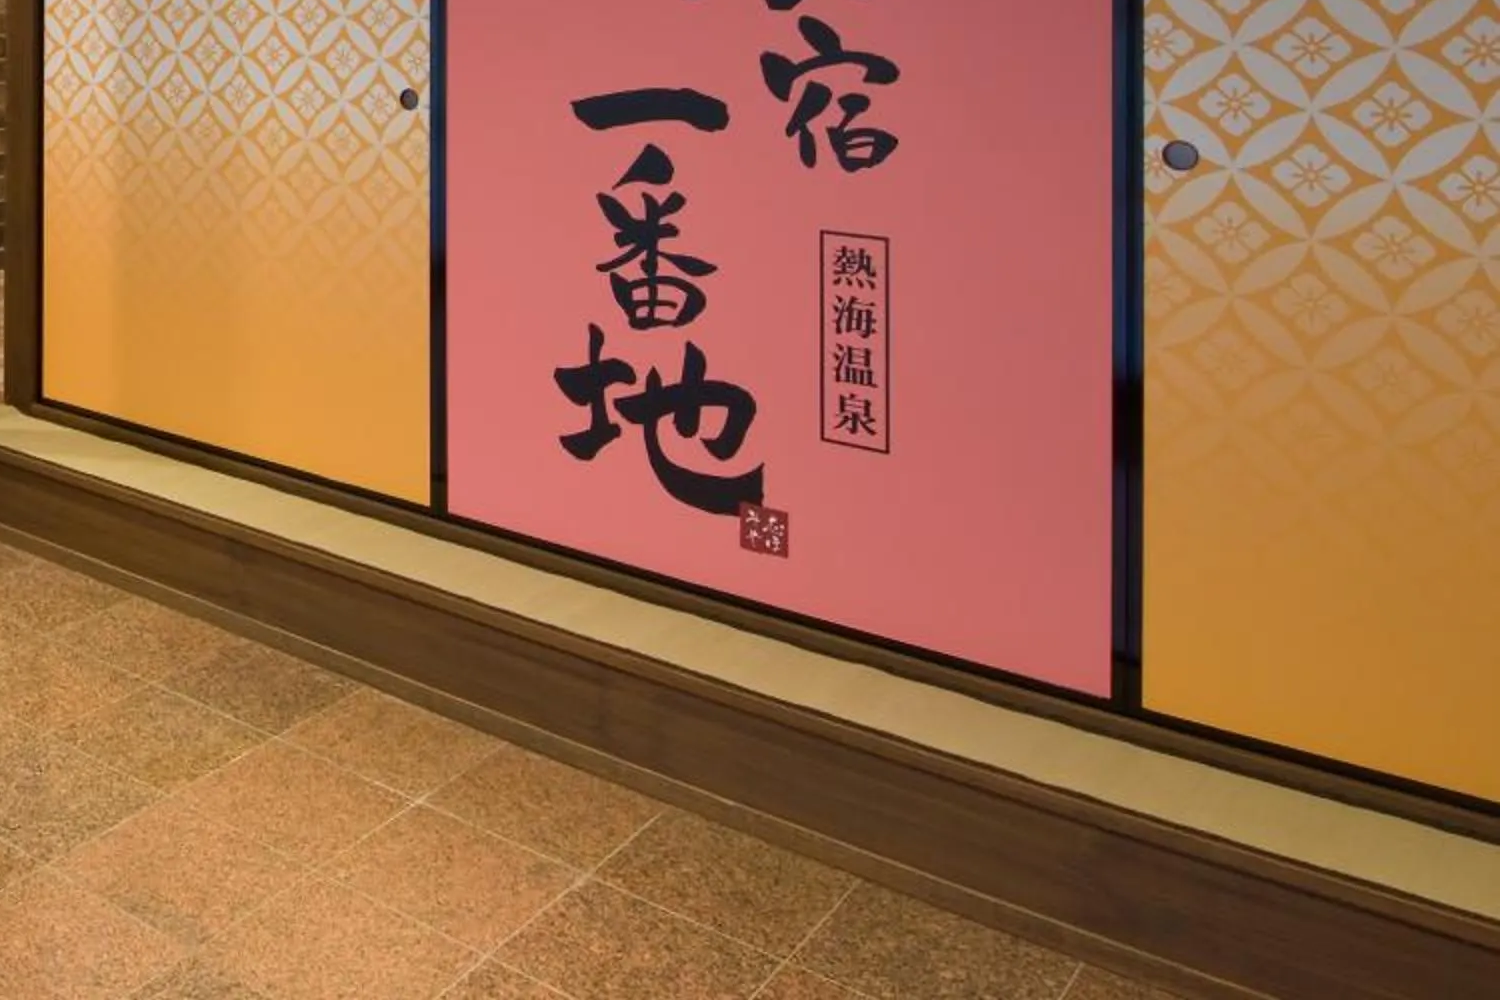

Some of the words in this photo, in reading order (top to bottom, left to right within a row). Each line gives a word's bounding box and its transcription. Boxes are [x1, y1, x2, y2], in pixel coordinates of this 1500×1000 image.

[554, 88, 765, 516] 一番地
[832, 246, 878, 436] 熱海温泉
